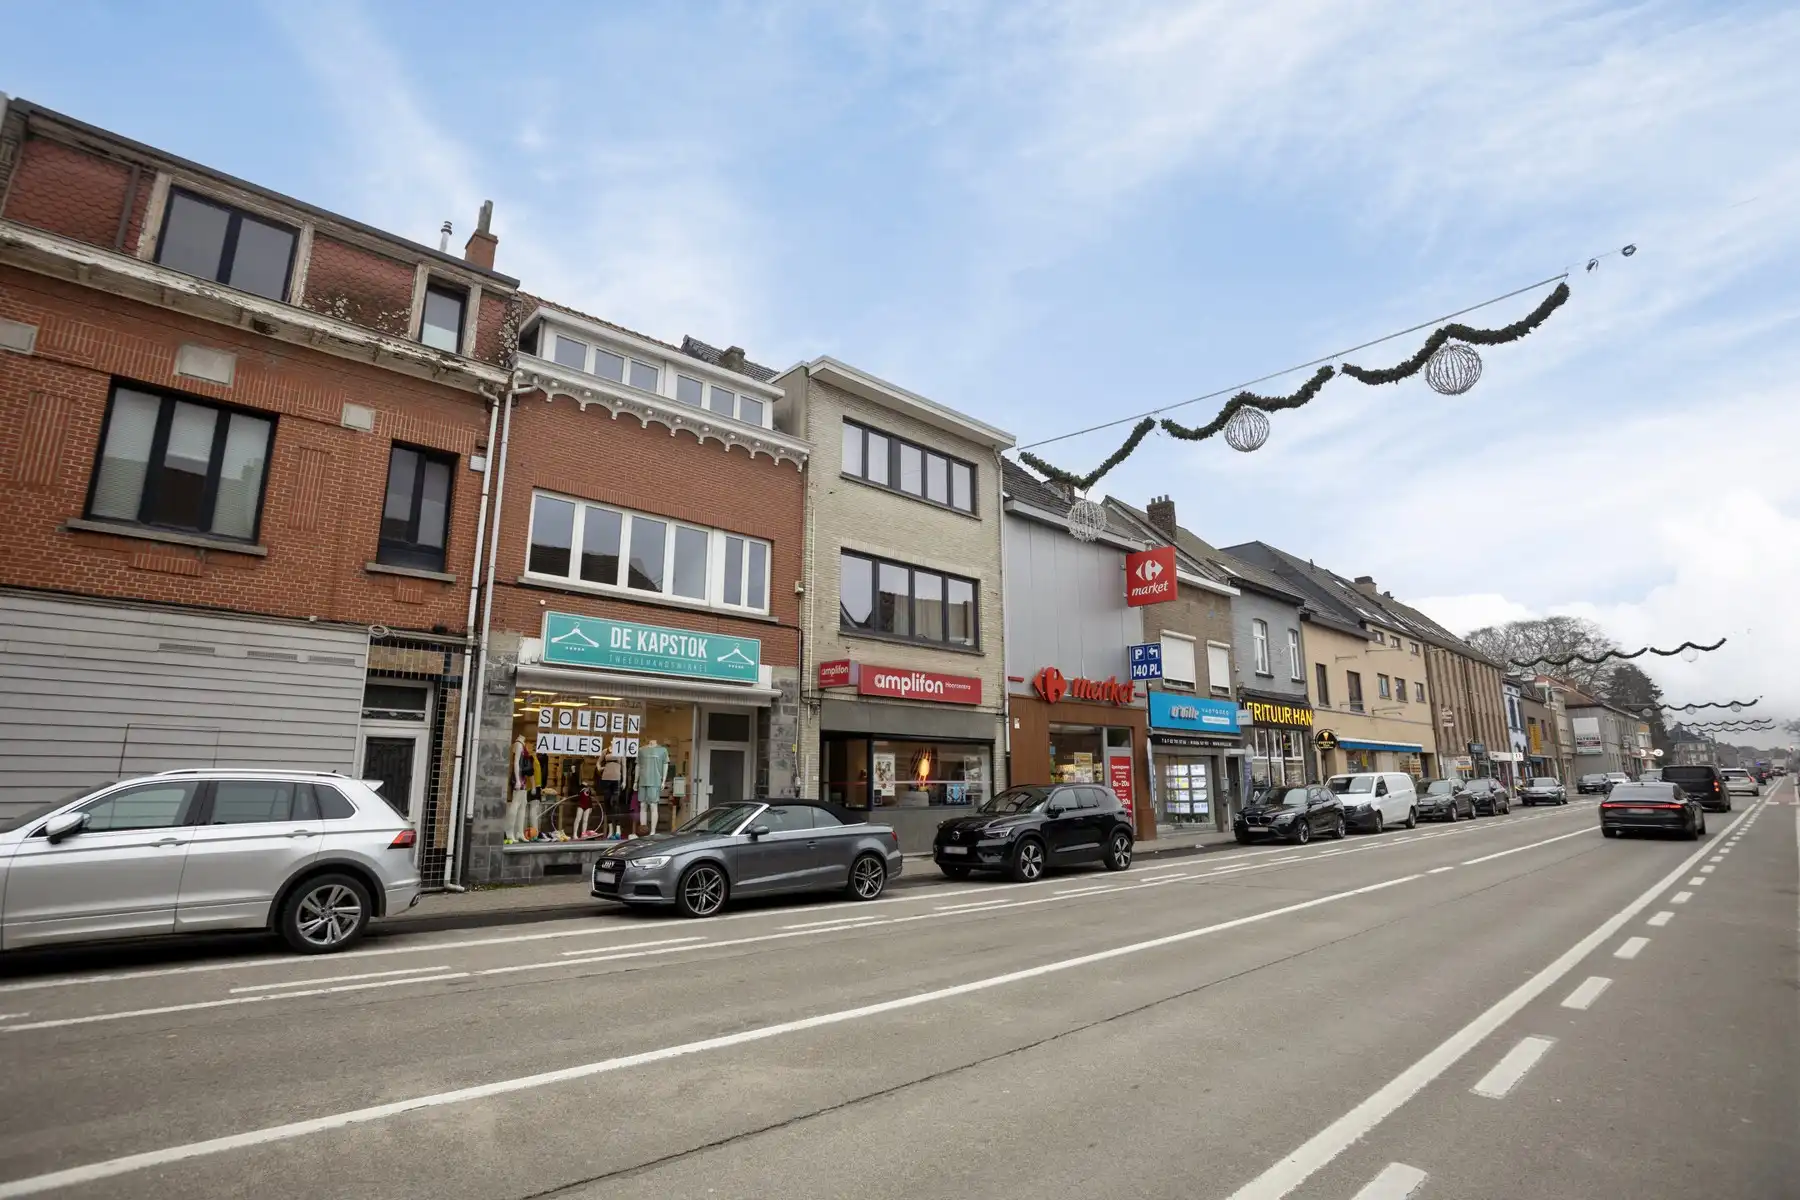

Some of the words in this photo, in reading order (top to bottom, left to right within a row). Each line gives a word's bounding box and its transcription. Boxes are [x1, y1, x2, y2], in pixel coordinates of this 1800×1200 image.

[1131, 580, 1169, 597] market
[610, 627, 632, 649] DE
[636, 629, 708, 659] KAPSTOK
[1135, 648, 1143, 660] P
[821, 664, 848, 677] amplifon
[1132, 663, 1147, 677] 140
[1149, 663, 1161, 676] PL.
[874, 673, 943, 695] amplifon
[1071, 676, 1134, 706] market
[540, 709, 640, 732] SOLDEN
[537, 735, 602, 754] ALLES
